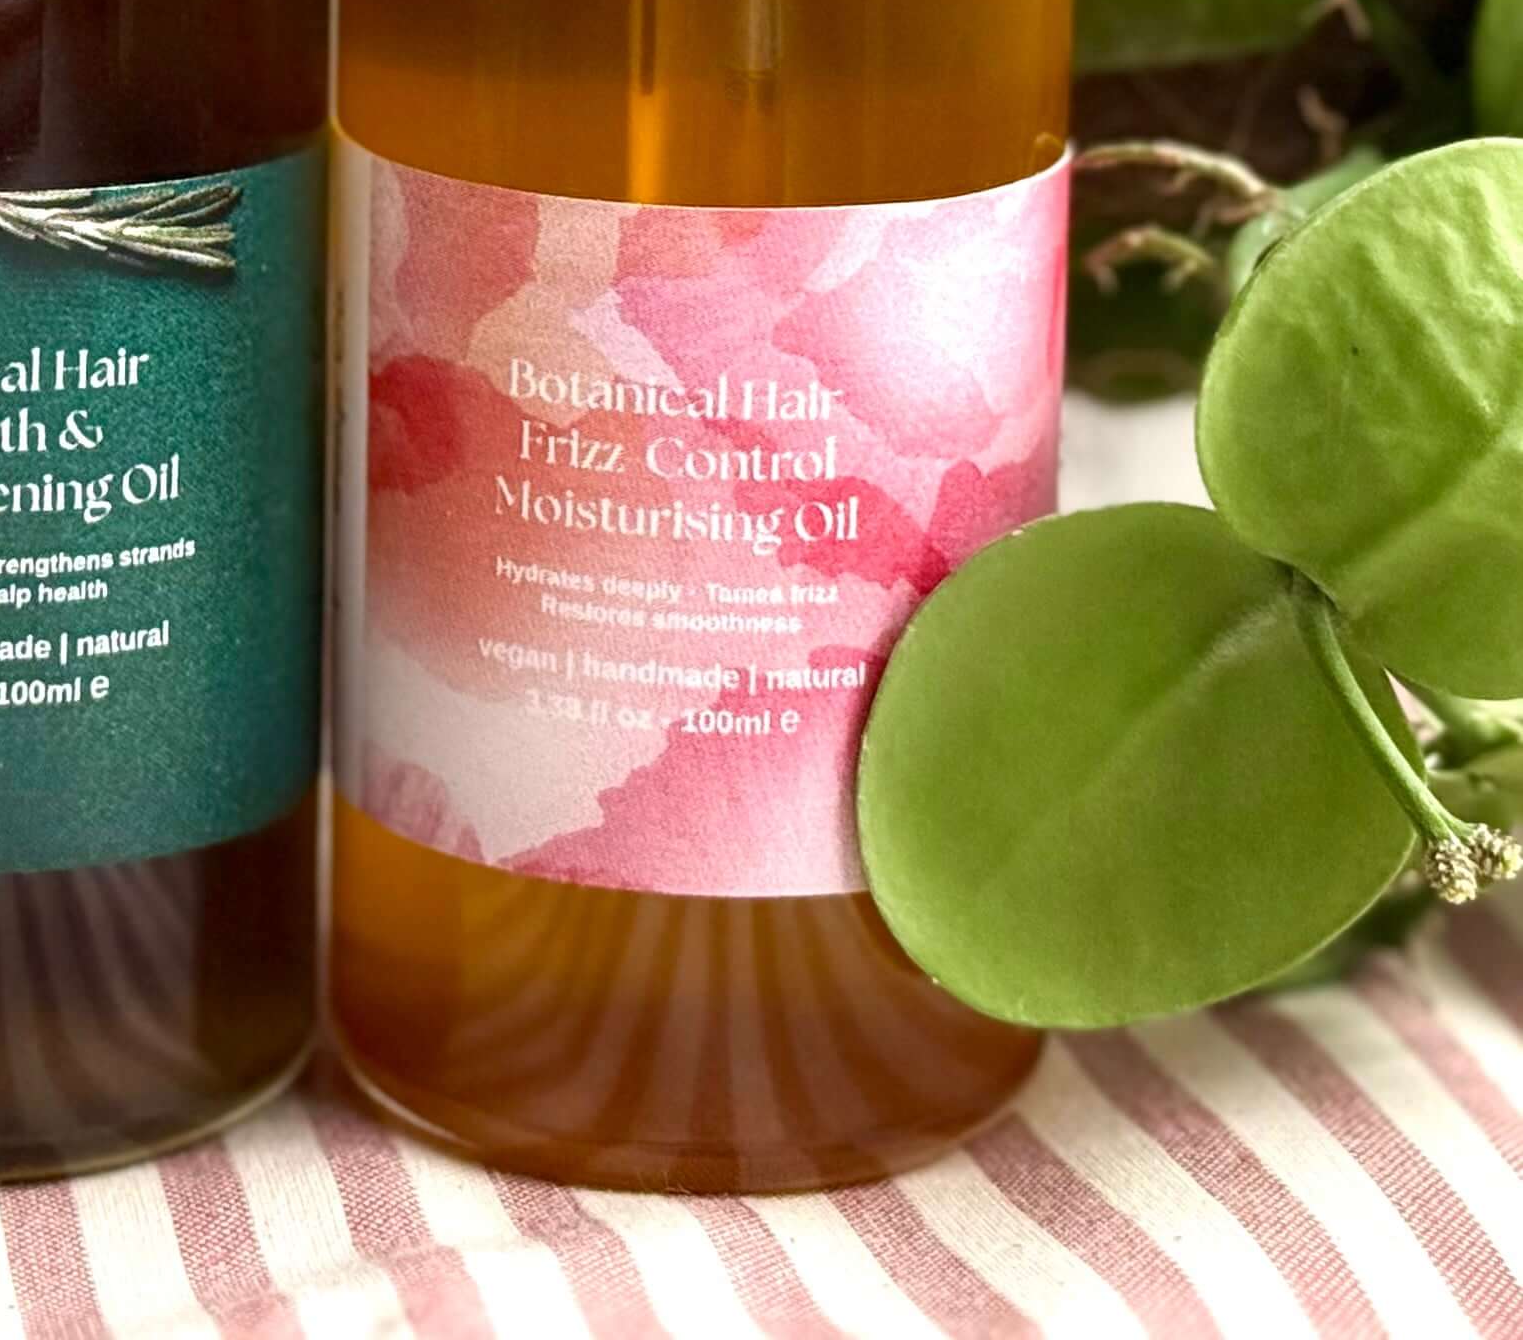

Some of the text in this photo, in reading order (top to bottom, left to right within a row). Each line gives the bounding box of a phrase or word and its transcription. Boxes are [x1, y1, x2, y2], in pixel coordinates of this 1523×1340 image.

[55, 348, 149, 390] Hair
[509, 358, 843, 420] Botanical Hair
[58, 409, 104, 451] &
[519, 419, 838, 481] Frizz Control
[122, 453, 179, 505] Oil
[495, 475, 859, 556] Moisturising Oil
[119, 537, 196, 566] strands
[38, 580, 108, 603] health
[496, 556, 839, 605] Hydrates deeply Tames frizz
[540, 594, 803, 634] Restores smoothness
[77, 620, 170, 657] natural
[479, 638, 558, 673] vegan
[582, 650, 740, 690] handmade
[766, 662, 866, 690] natural
[681, 709, 770, 735] 100ml
